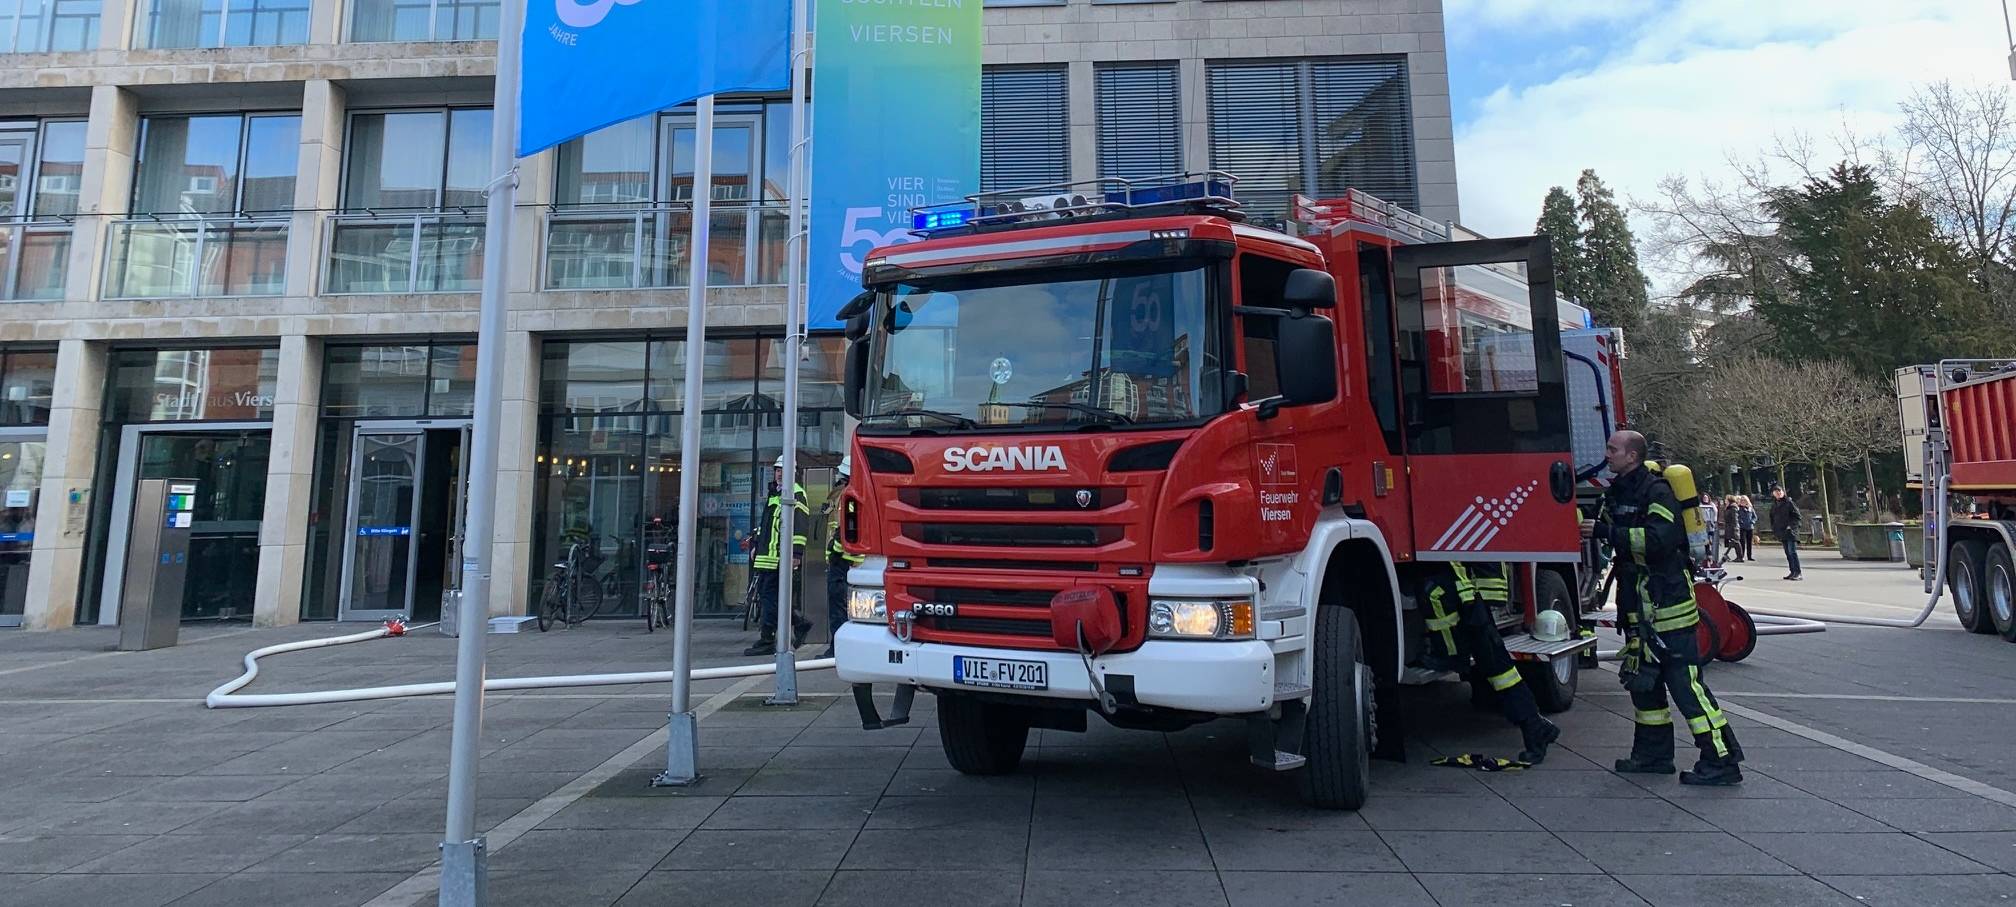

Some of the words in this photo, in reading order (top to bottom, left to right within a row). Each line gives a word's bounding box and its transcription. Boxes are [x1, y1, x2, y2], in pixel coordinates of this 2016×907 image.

[548, 22, 578, 46] JAHRE
[849, 23, 952, 45] VIERSEN
[887, 176, 924, 191] VIER
[887, 193, 926, 208] SIND
[887, 210, 912, 225] VIE
[943, 445, 1068, 472] SCANIA
[1260, 489, 1298, 505] Feuerwehr
[1261, 506, 1291, 521] Viersen
[913, 603, 923, 615] P
[925, 603, 954, 616] 360
[964, 660, 989, 680] VIE
[999, 662, 1016, 682] FV
[1018, 664, 1044, 684] 201
